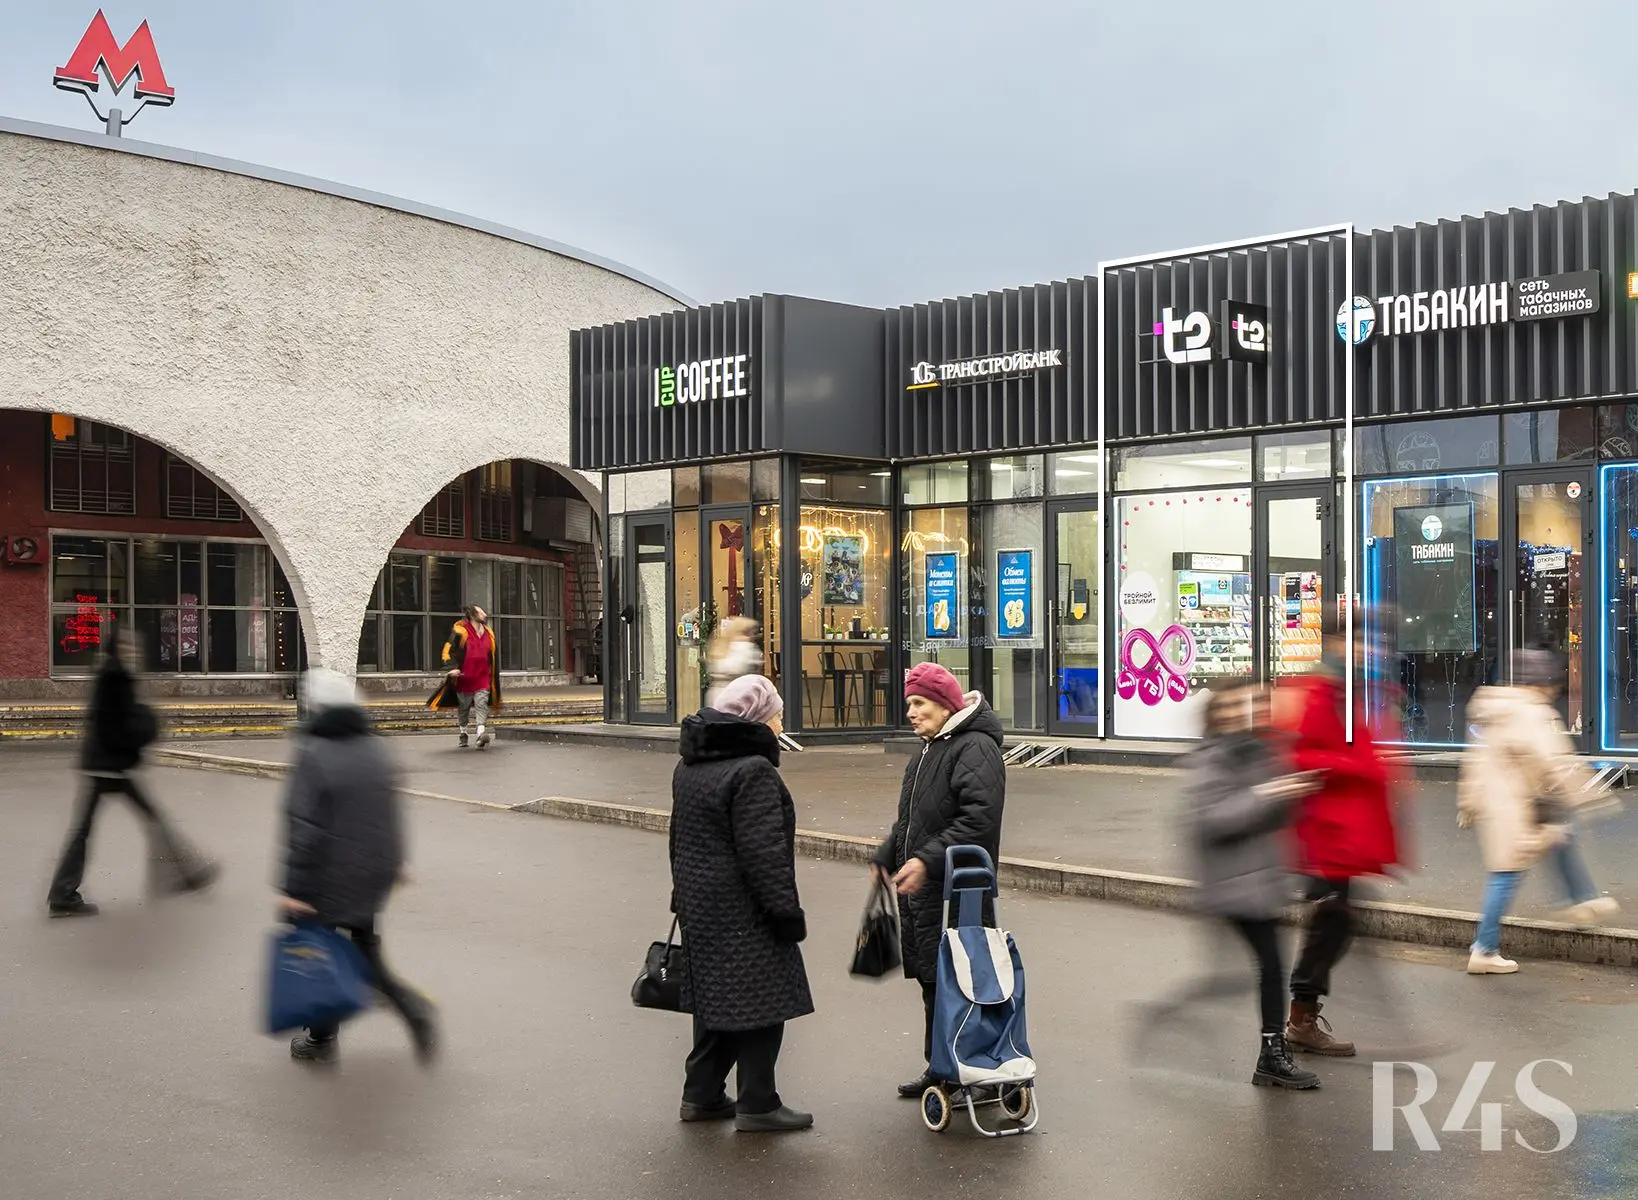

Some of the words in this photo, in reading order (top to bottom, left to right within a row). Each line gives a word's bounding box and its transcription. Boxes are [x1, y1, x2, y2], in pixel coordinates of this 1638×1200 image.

[1519, 279, 1550, 293] сеть
[1519, 288, 1587, 306] табачных
[1378, 281, 1508, 337] ТАБАКИН
[1519, 298, 1593, 317] магазинов
[938, 349, 1063, 381] ТРАНССТРОЙБАНК
[661, 366, 675, 406] CUP
[676, 354, 747, 404] COFFEE
[1411, 543, 1454, 559] ТАБАКИН
[1124, 591, 1152, 599] ТРОЙНОЙ
[1143, 678, 1159, 696] ГБ
